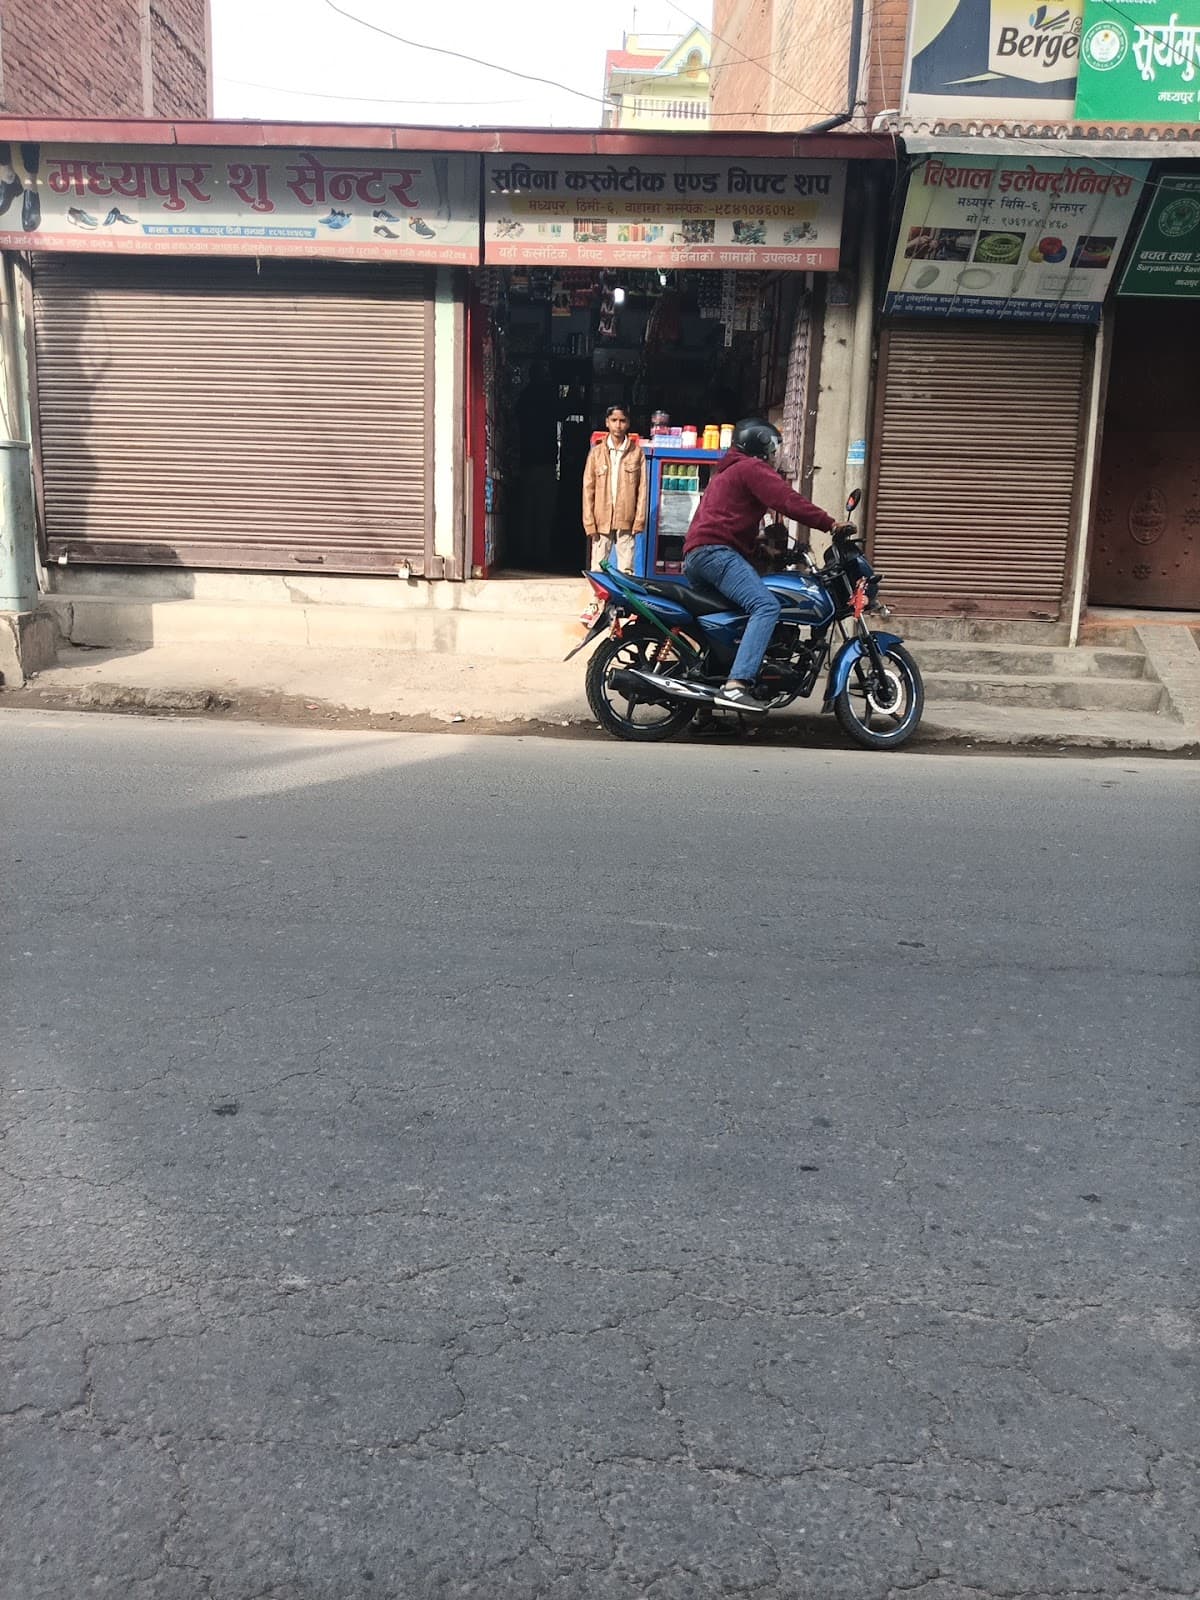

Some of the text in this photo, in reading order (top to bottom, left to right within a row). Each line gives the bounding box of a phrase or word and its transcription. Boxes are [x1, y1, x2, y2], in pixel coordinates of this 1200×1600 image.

[997, 26, 1080, 67] Berge
[1132, 13, 1200, 81] सूर्यमु
[1158, 91, 1196, 104] मध्यपुर
[46, 151, 423, 214] मध्यपुर शु सेन्टर
[673, 169, 720, 193] एण्ड
[727, 165, 787, 195] गिफ्ट
[794, 170, 832, 196] शप
[923, 160, 1132, 198] विशाल इलेक्ट्रोनिक्स
